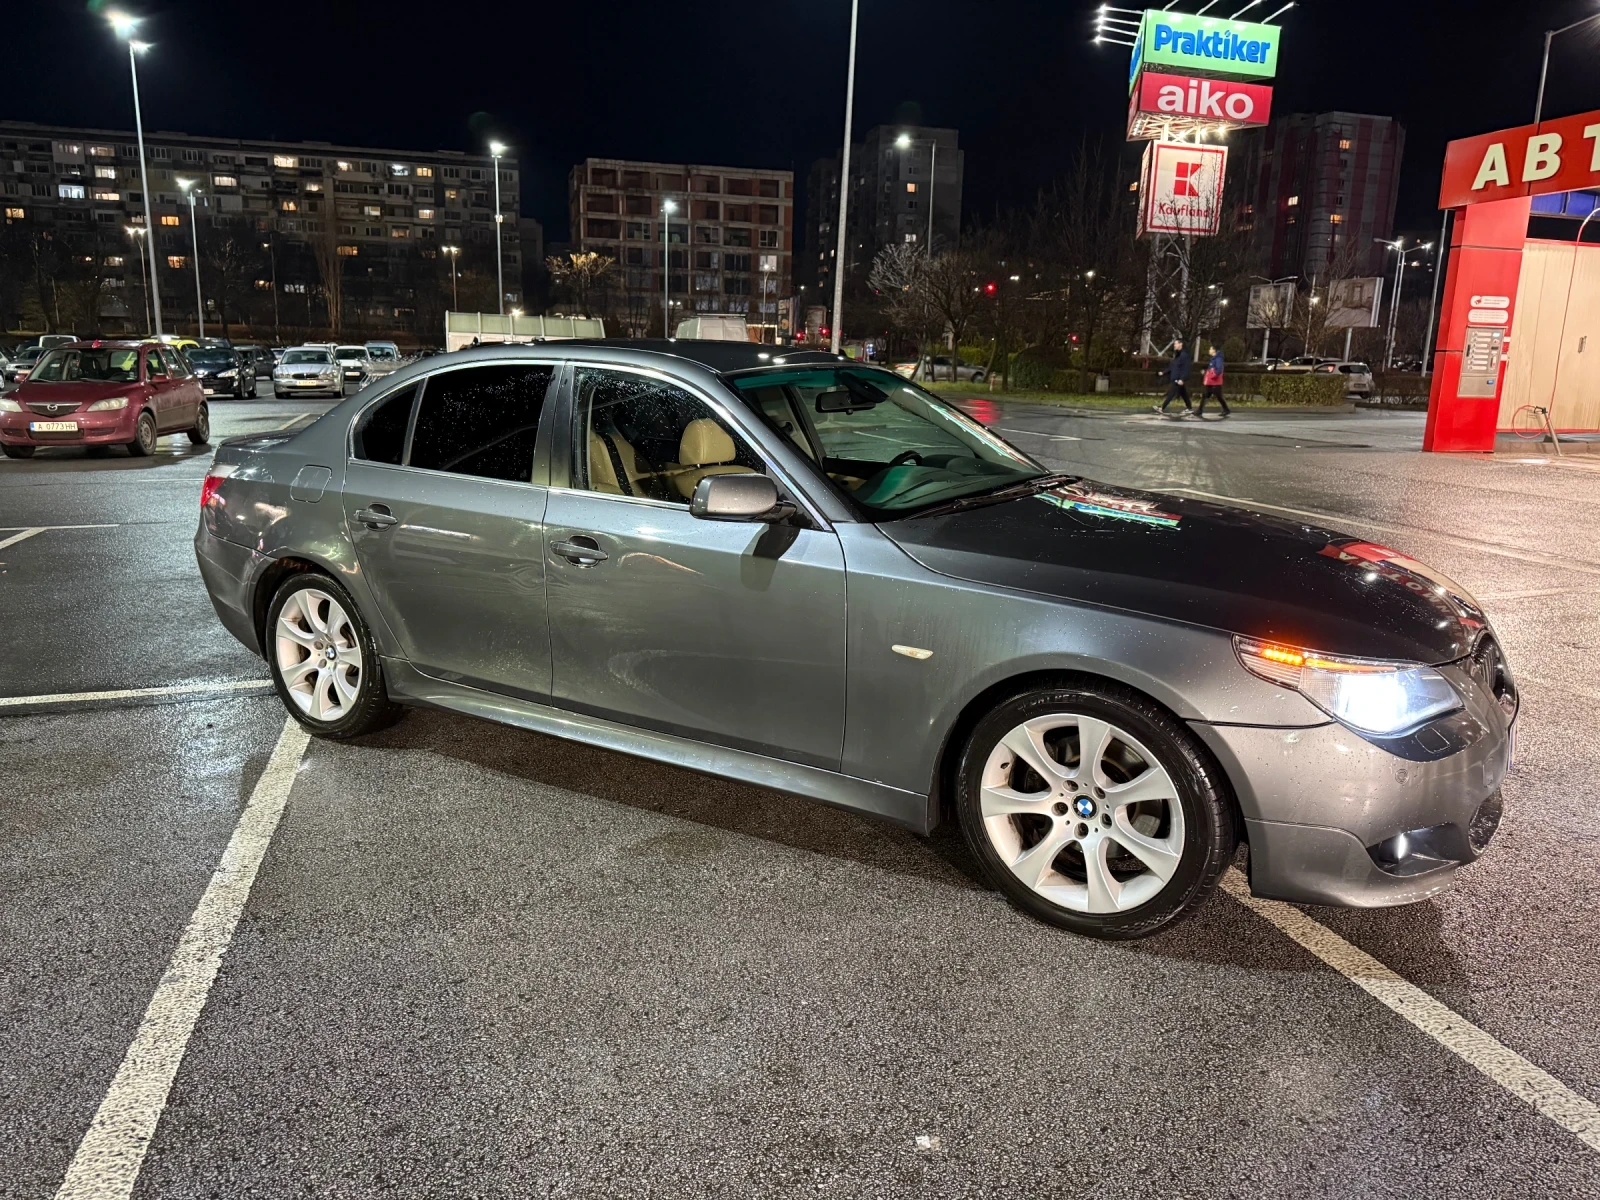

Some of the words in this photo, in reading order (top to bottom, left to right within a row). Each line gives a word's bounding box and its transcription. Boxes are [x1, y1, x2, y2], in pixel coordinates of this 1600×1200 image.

[1154, 23, 1271, 64] Praktiker
[1157, 79, 1254, 120] aiko
[1158, 202, 1210, 218] Kaufland
